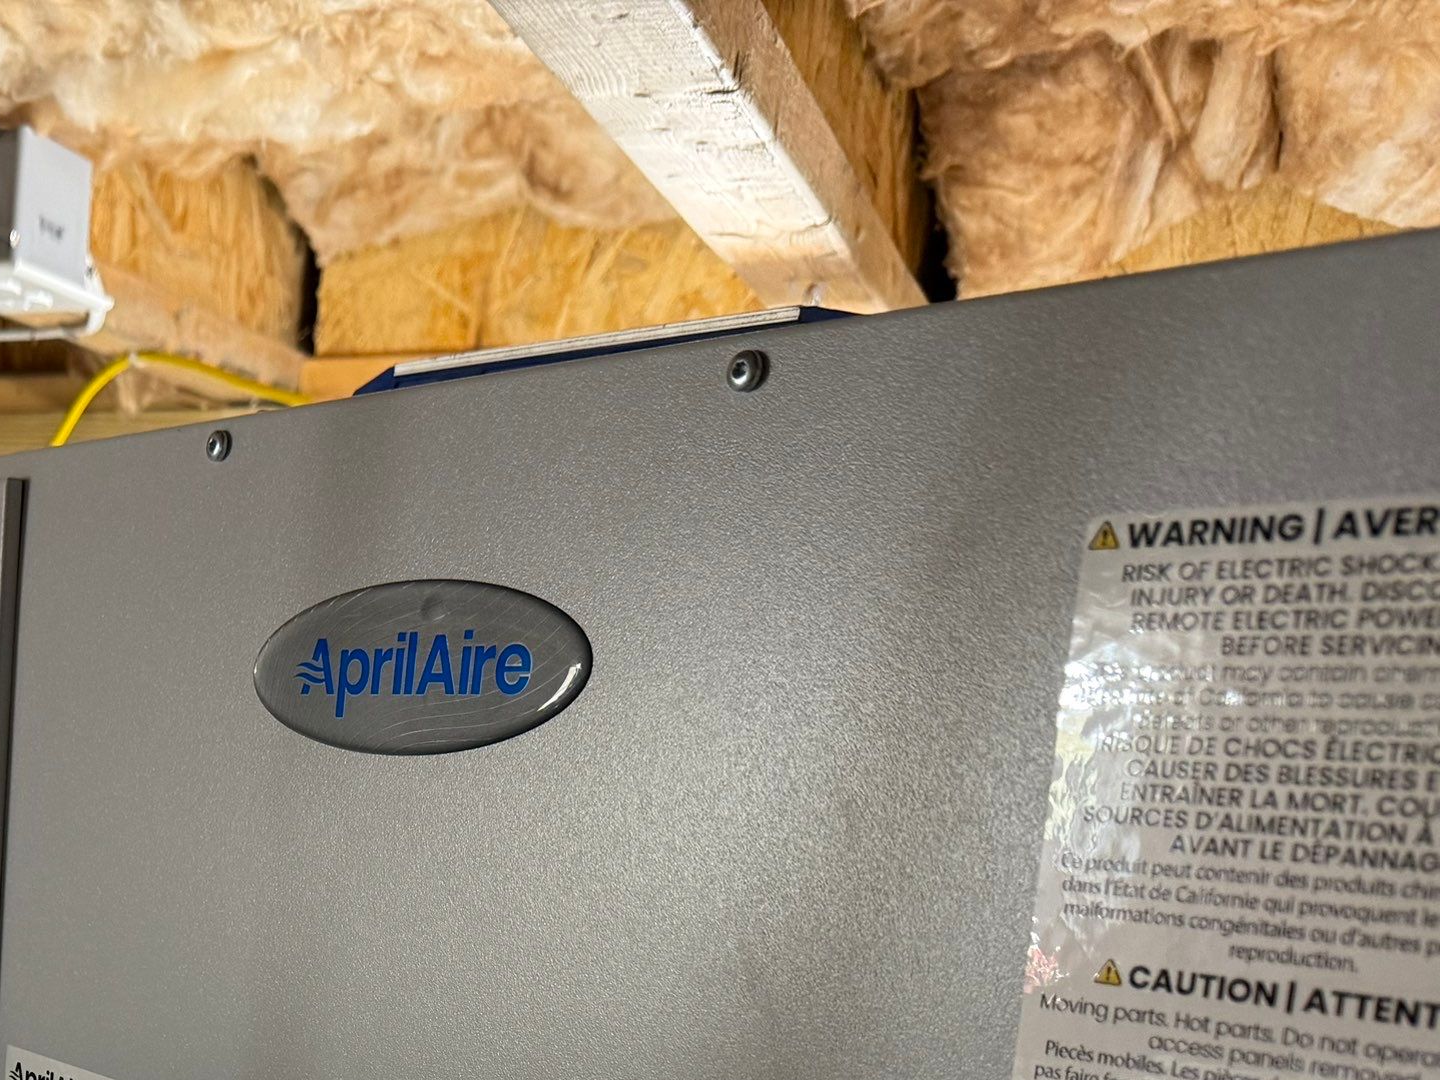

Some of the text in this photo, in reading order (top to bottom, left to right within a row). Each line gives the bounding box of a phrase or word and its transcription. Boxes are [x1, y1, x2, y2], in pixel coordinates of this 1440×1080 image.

[1128, 506, 1438, 547] WARNING AVER
[1123, 557, 1330, 581] RISK OF ELECTRIC
[1131, 585, 1253, 606] INJURY OR
[1132, 609, 1346, 630] REMOTE ELECTRIC
[1222, 636, 1309, 655] BEFORE
[293, 629, 533, 718] AprilAire
[1188, 735, 1216, 754] DE
[1224, 736, 1315, 758] CHOCS
[1127, 759, 1415, 789] CAUSER DES BLESSURES
[1121, 780, 1277, 807] ENTRAÎNER LA
[1084, 804, 1407, 843] SOURCES D'ALIMENTATION
[1170, 834, 1250, 857] AVANT
[1260, 841, 1282, 859] LE
[1084, 857, 1268, 884] produit peut contenir
[1062, 875, 1259, 909] dans de Californie
[1064, 901, 1184, 926] malformations
[1129, 964, 1276, 1007] CAUTION
[1041, 992, 1357, 1055] Moving parts. Hot Do not
[1148, 1035, 1304, 1072] access panels
[1034, 1064, 1061, 1080] pas
[1171, 1061, 1196, 1080] Les
